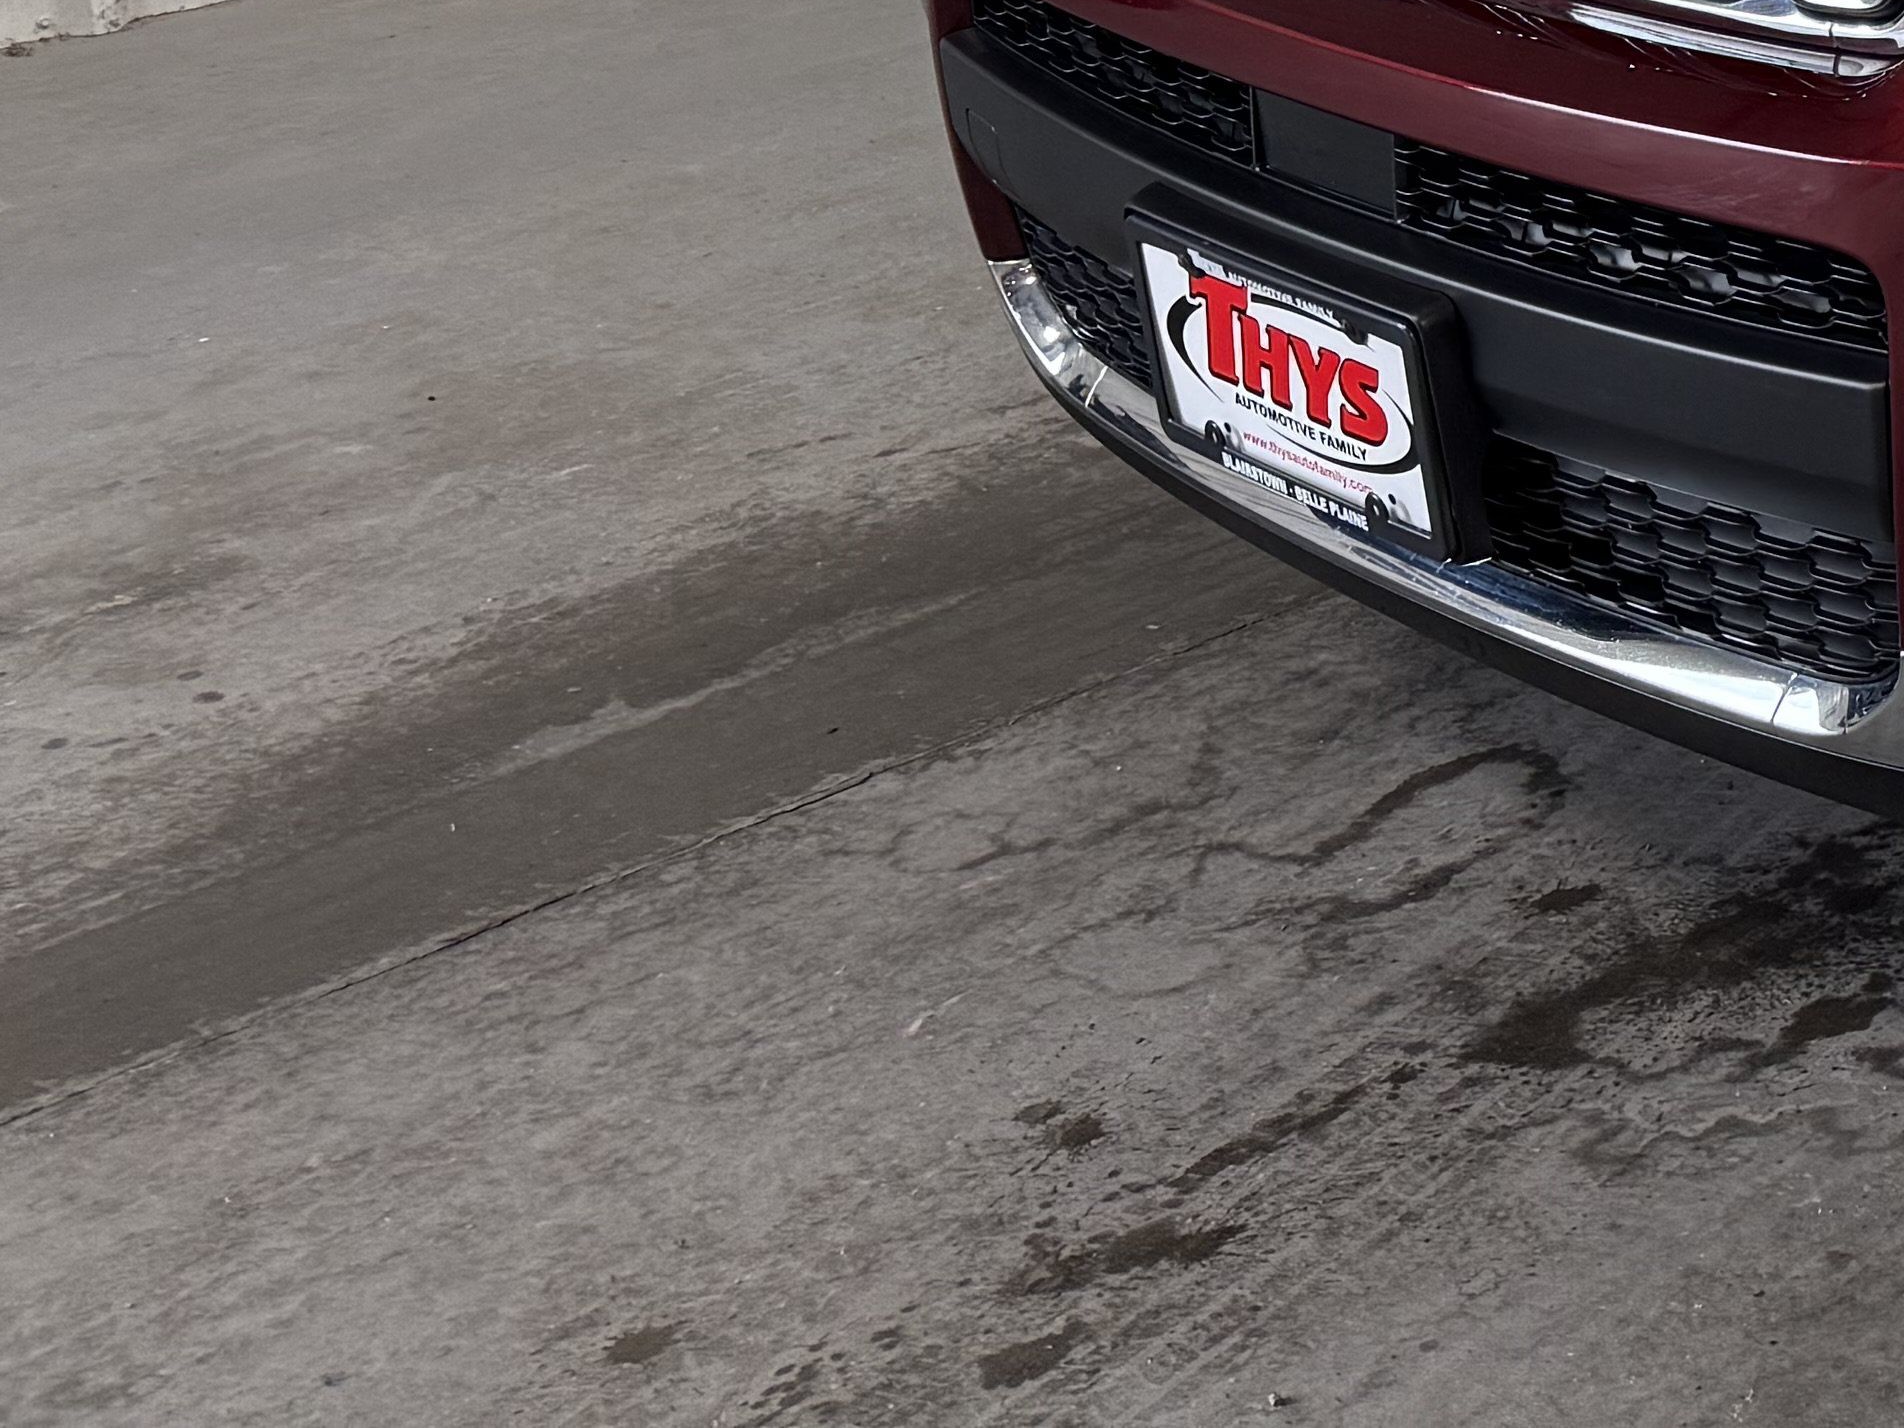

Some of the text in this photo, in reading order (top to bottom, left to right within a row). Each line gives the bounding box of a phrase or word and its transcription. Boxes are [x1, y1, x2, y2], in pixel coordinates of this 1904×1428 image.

[1189, 273, 1389, 447] THYS
[1234, 391, 1368, 463] AUTOMOTIVE FAMILY
